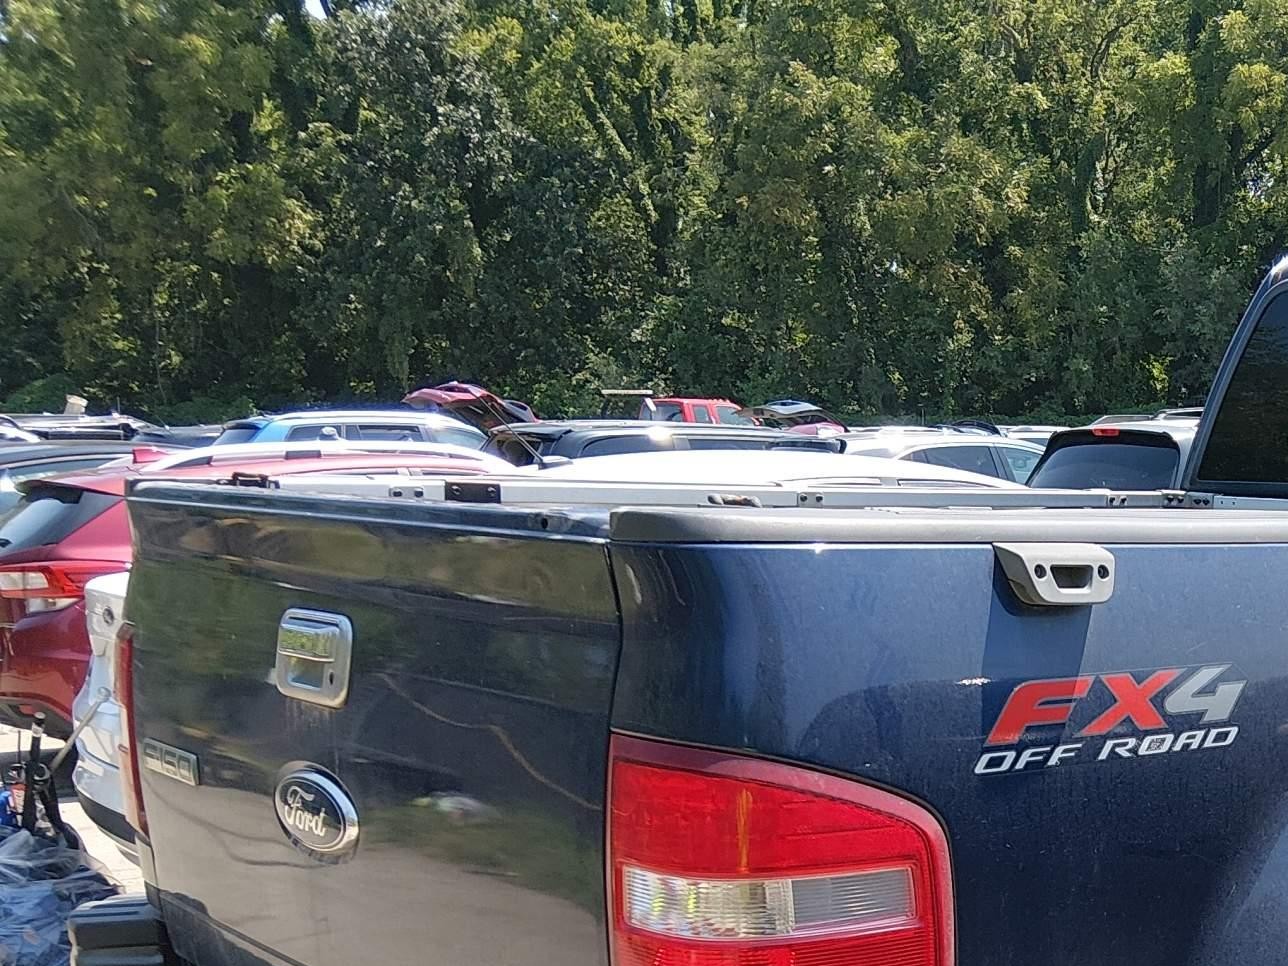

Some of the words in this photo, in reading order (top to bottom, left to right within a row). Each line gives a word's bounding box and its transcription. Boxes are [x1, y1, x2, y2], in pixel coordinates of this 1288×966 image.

[984, 663, 1247, 746] FX4
[974, 743, 1083, 775] OFF
[1097, 726, 1240, 761] ROAD
[284, 785, 327, 837] Ford
